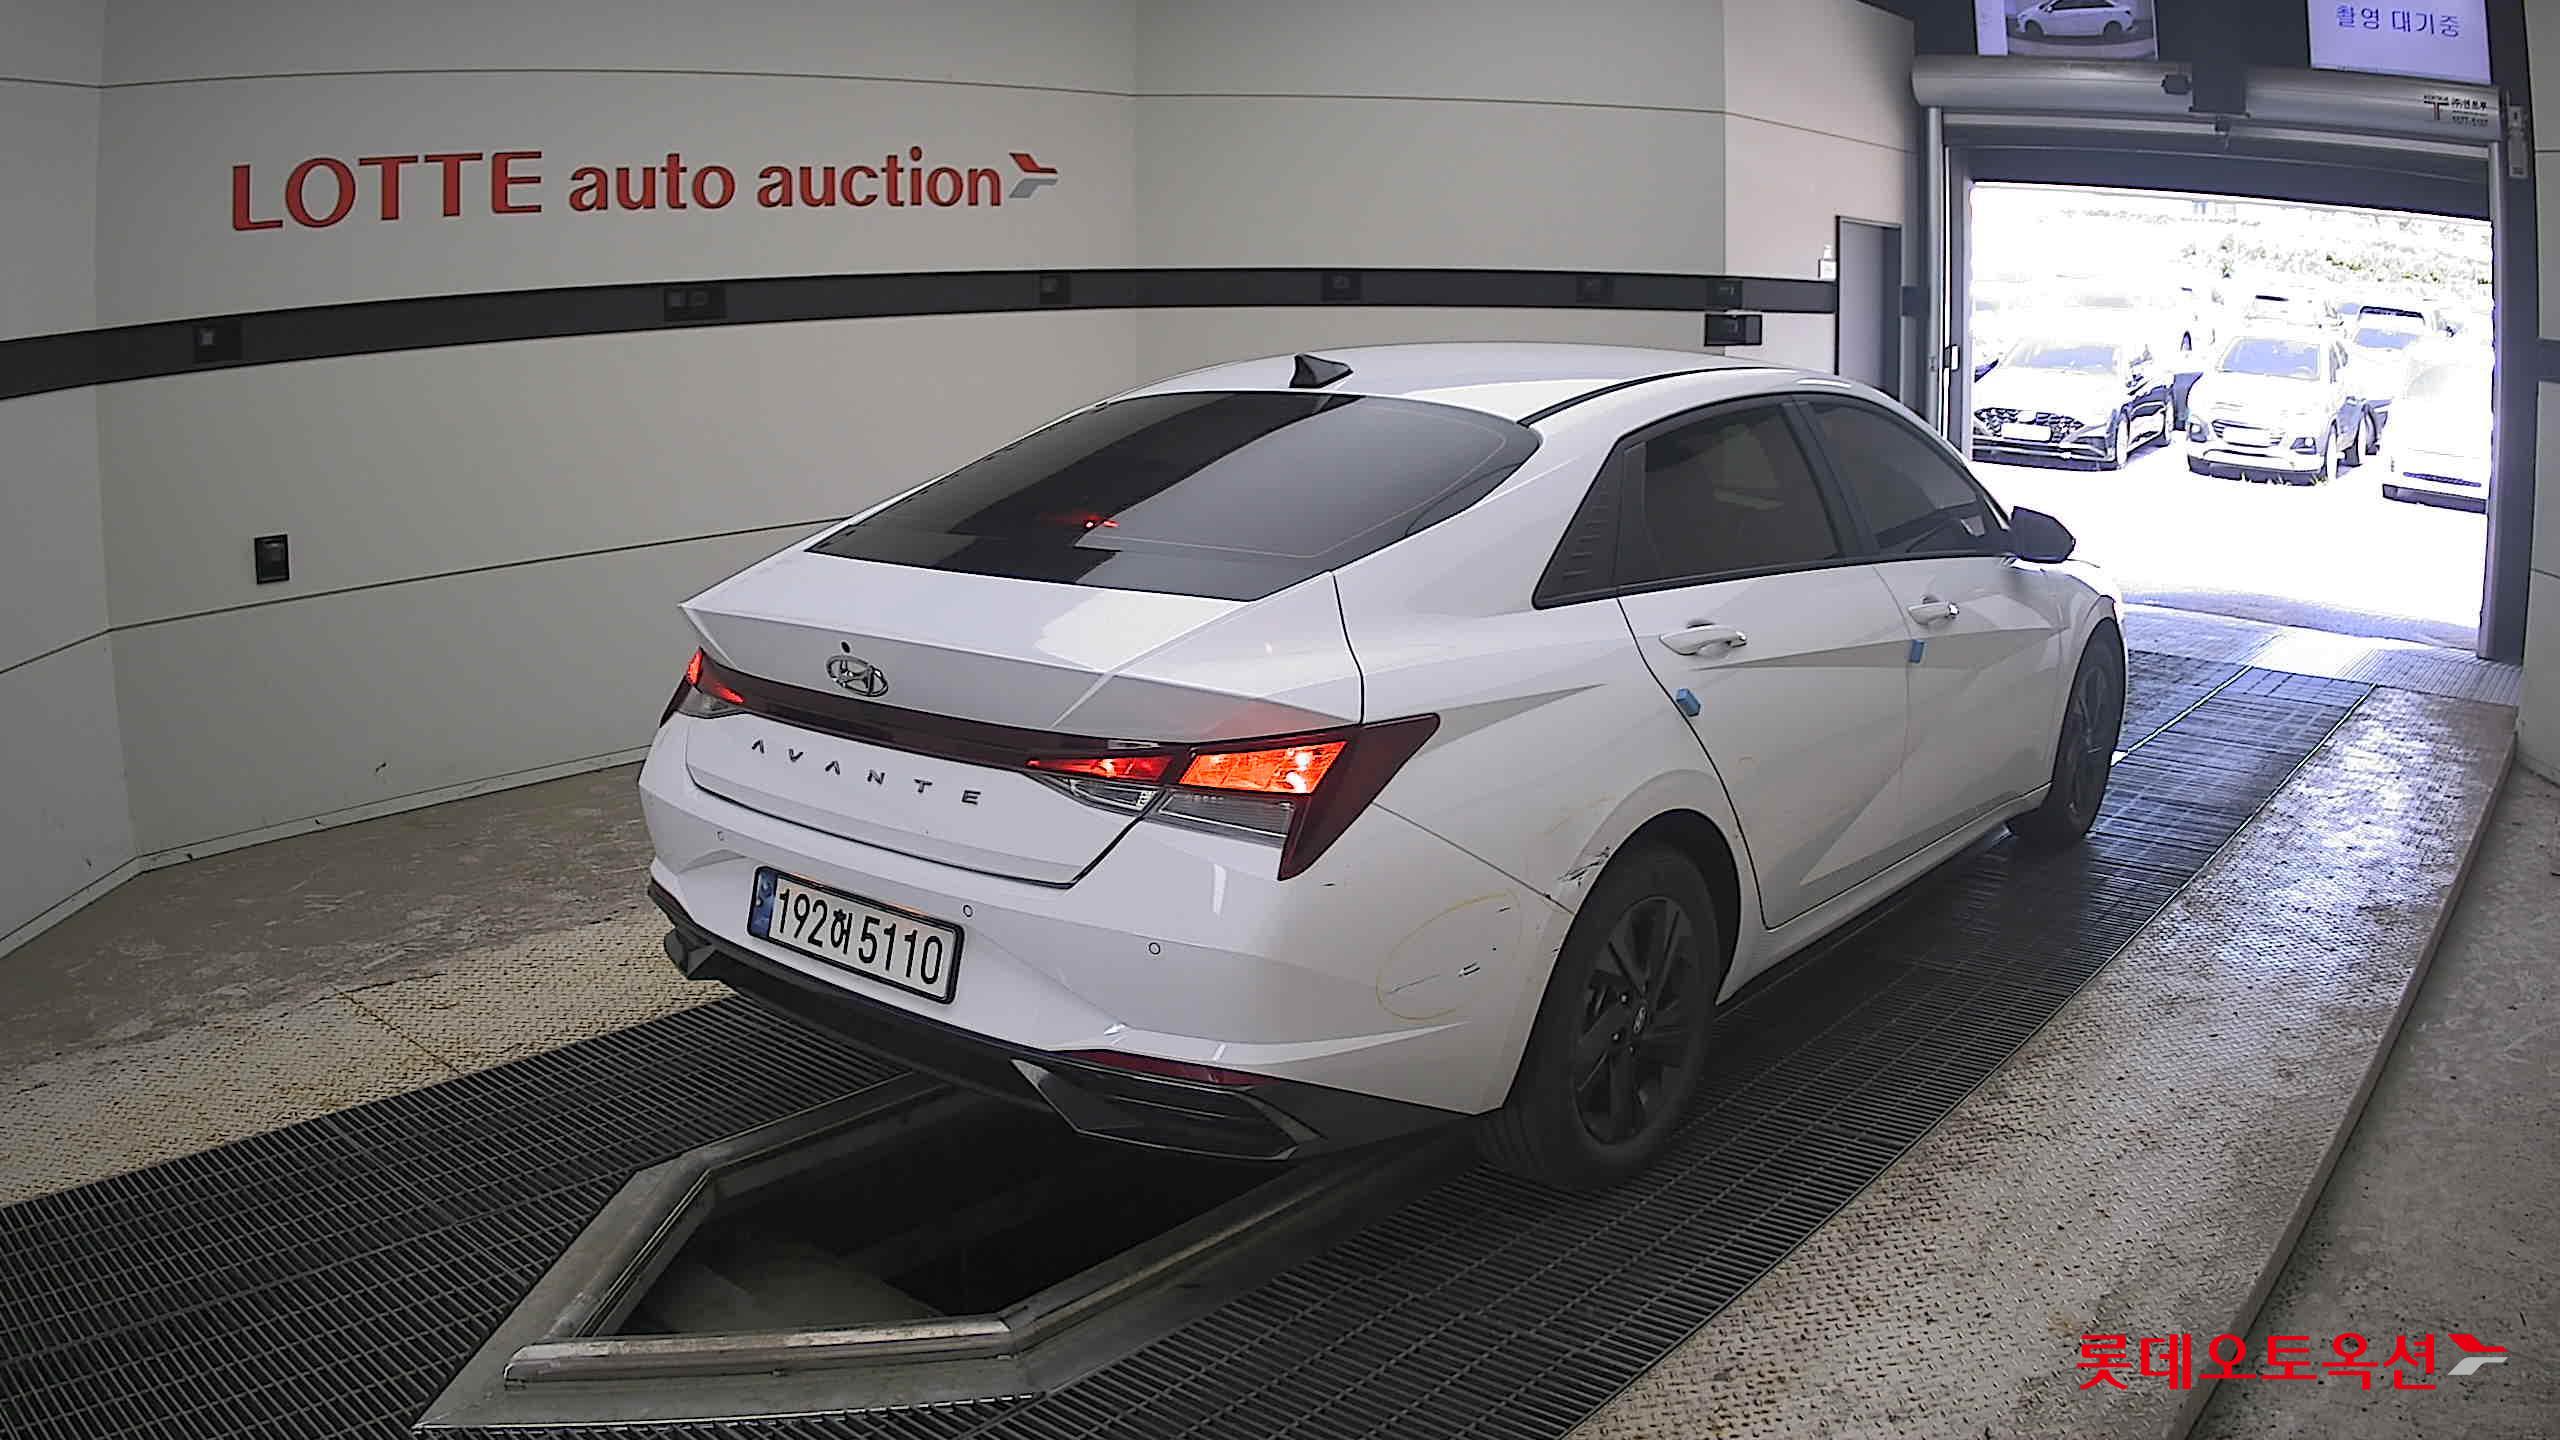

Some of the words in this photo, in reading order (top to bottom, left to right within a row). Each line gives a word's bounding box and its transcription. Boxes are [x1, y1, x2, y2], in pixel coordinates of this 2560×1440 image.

[2337, 5, 2381, 30] 촬영
[2391, 11, 2459, 37] 대기중
[232, 151, 542, 231] LOTTE
[568, 153, 737, 210] auto
[756, 146, 1002, 208] auction
[751, 739, 981, 805] AVANTE
[778, 888, 853, 954] 192허
[857, 915, 943, 985] 5110
